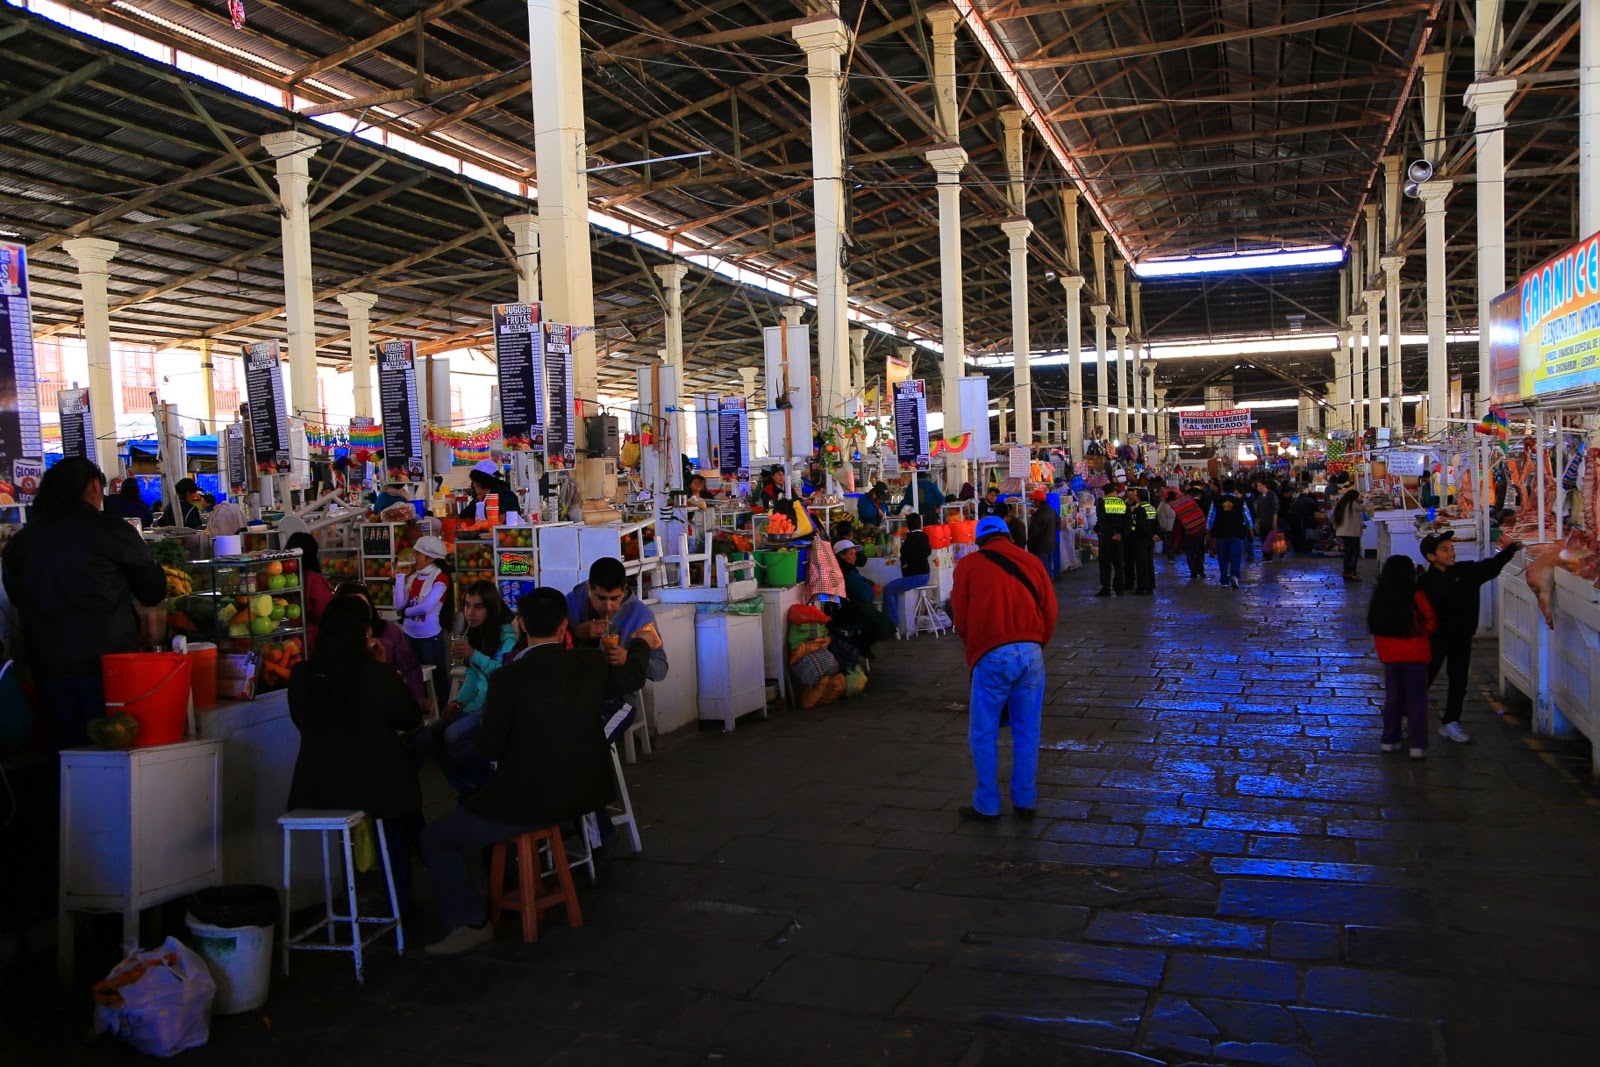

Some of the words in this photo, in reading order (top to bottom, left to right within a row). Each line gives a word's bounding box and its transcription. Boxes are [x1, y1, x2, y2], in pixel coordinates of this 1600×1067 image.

[504, 305, 526, 314] JUGOS
[506, 315, 532, 324] FRUTAS
[551, 335, 566, 343] FRUTAS
[386, 353, 405, 361] FRUTAS
